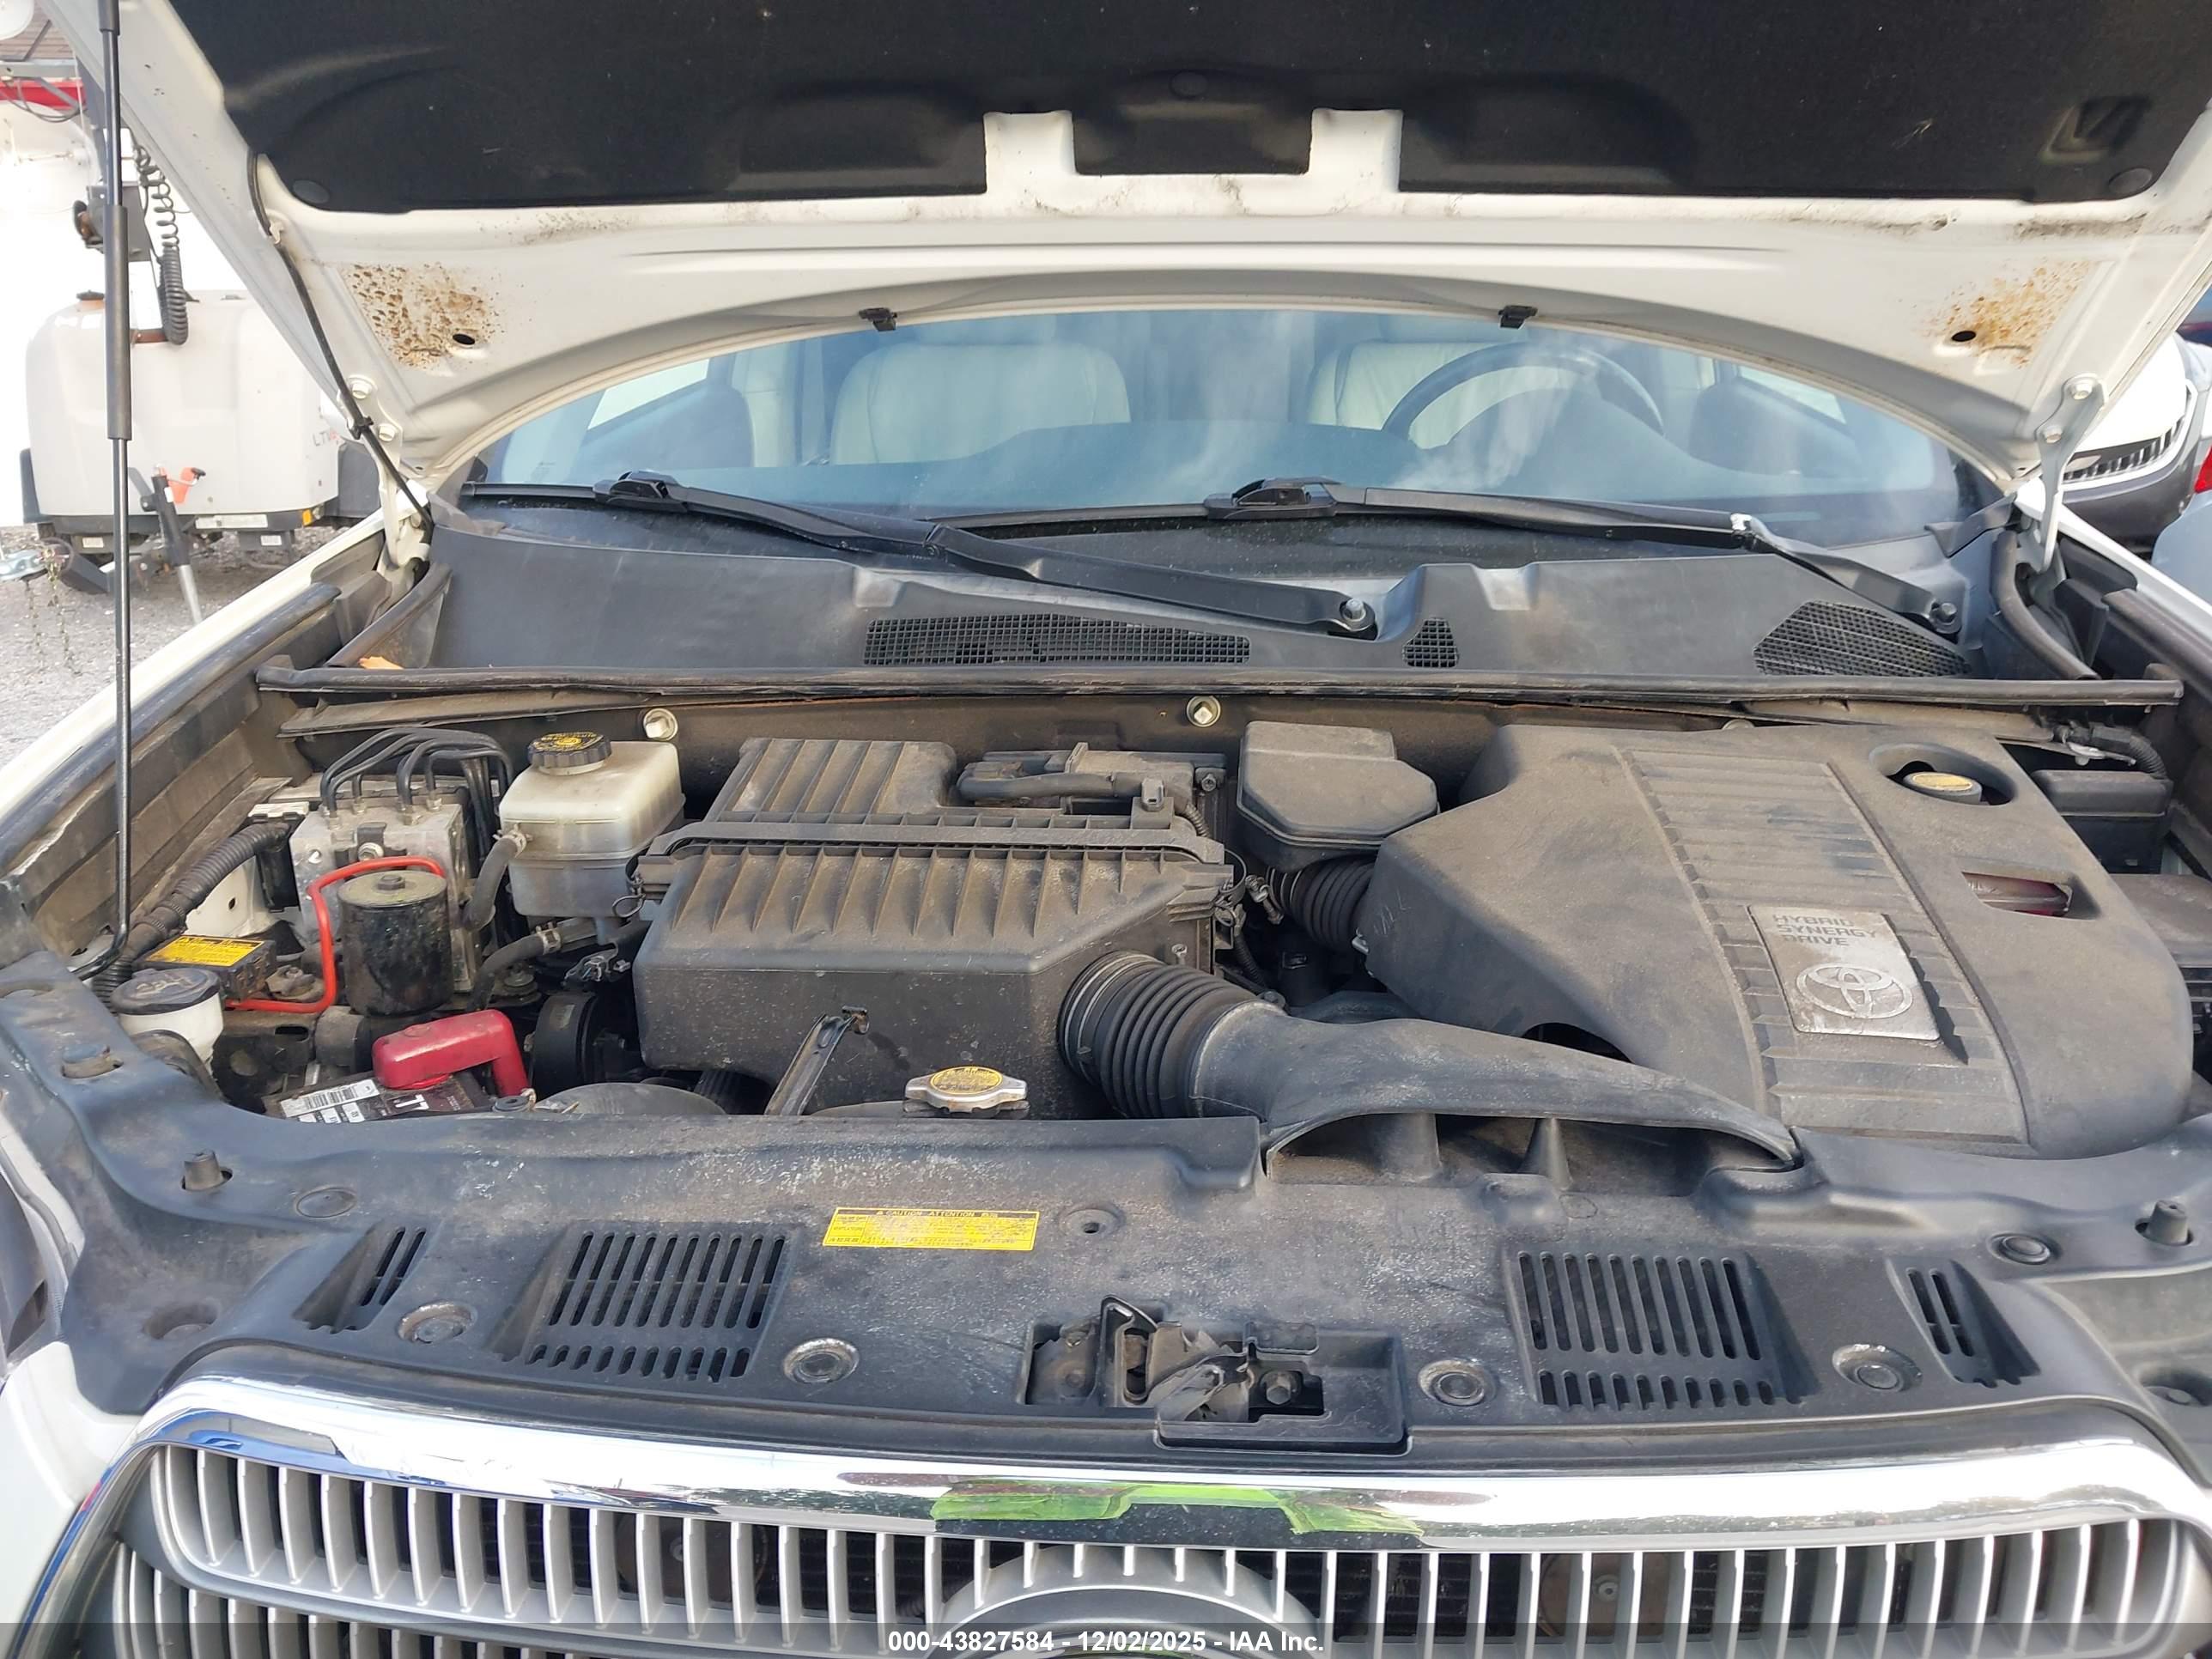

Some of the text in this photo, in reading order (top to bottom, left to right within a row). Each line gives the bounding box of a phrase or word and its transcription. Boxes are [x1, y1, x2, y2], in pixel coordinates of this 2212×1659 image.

[1772, 914, 1855, 927] HYBRID
[1776, 925, 1876, 939] SYNERGY
[1781, 934, 1850, 946] DRIVE
